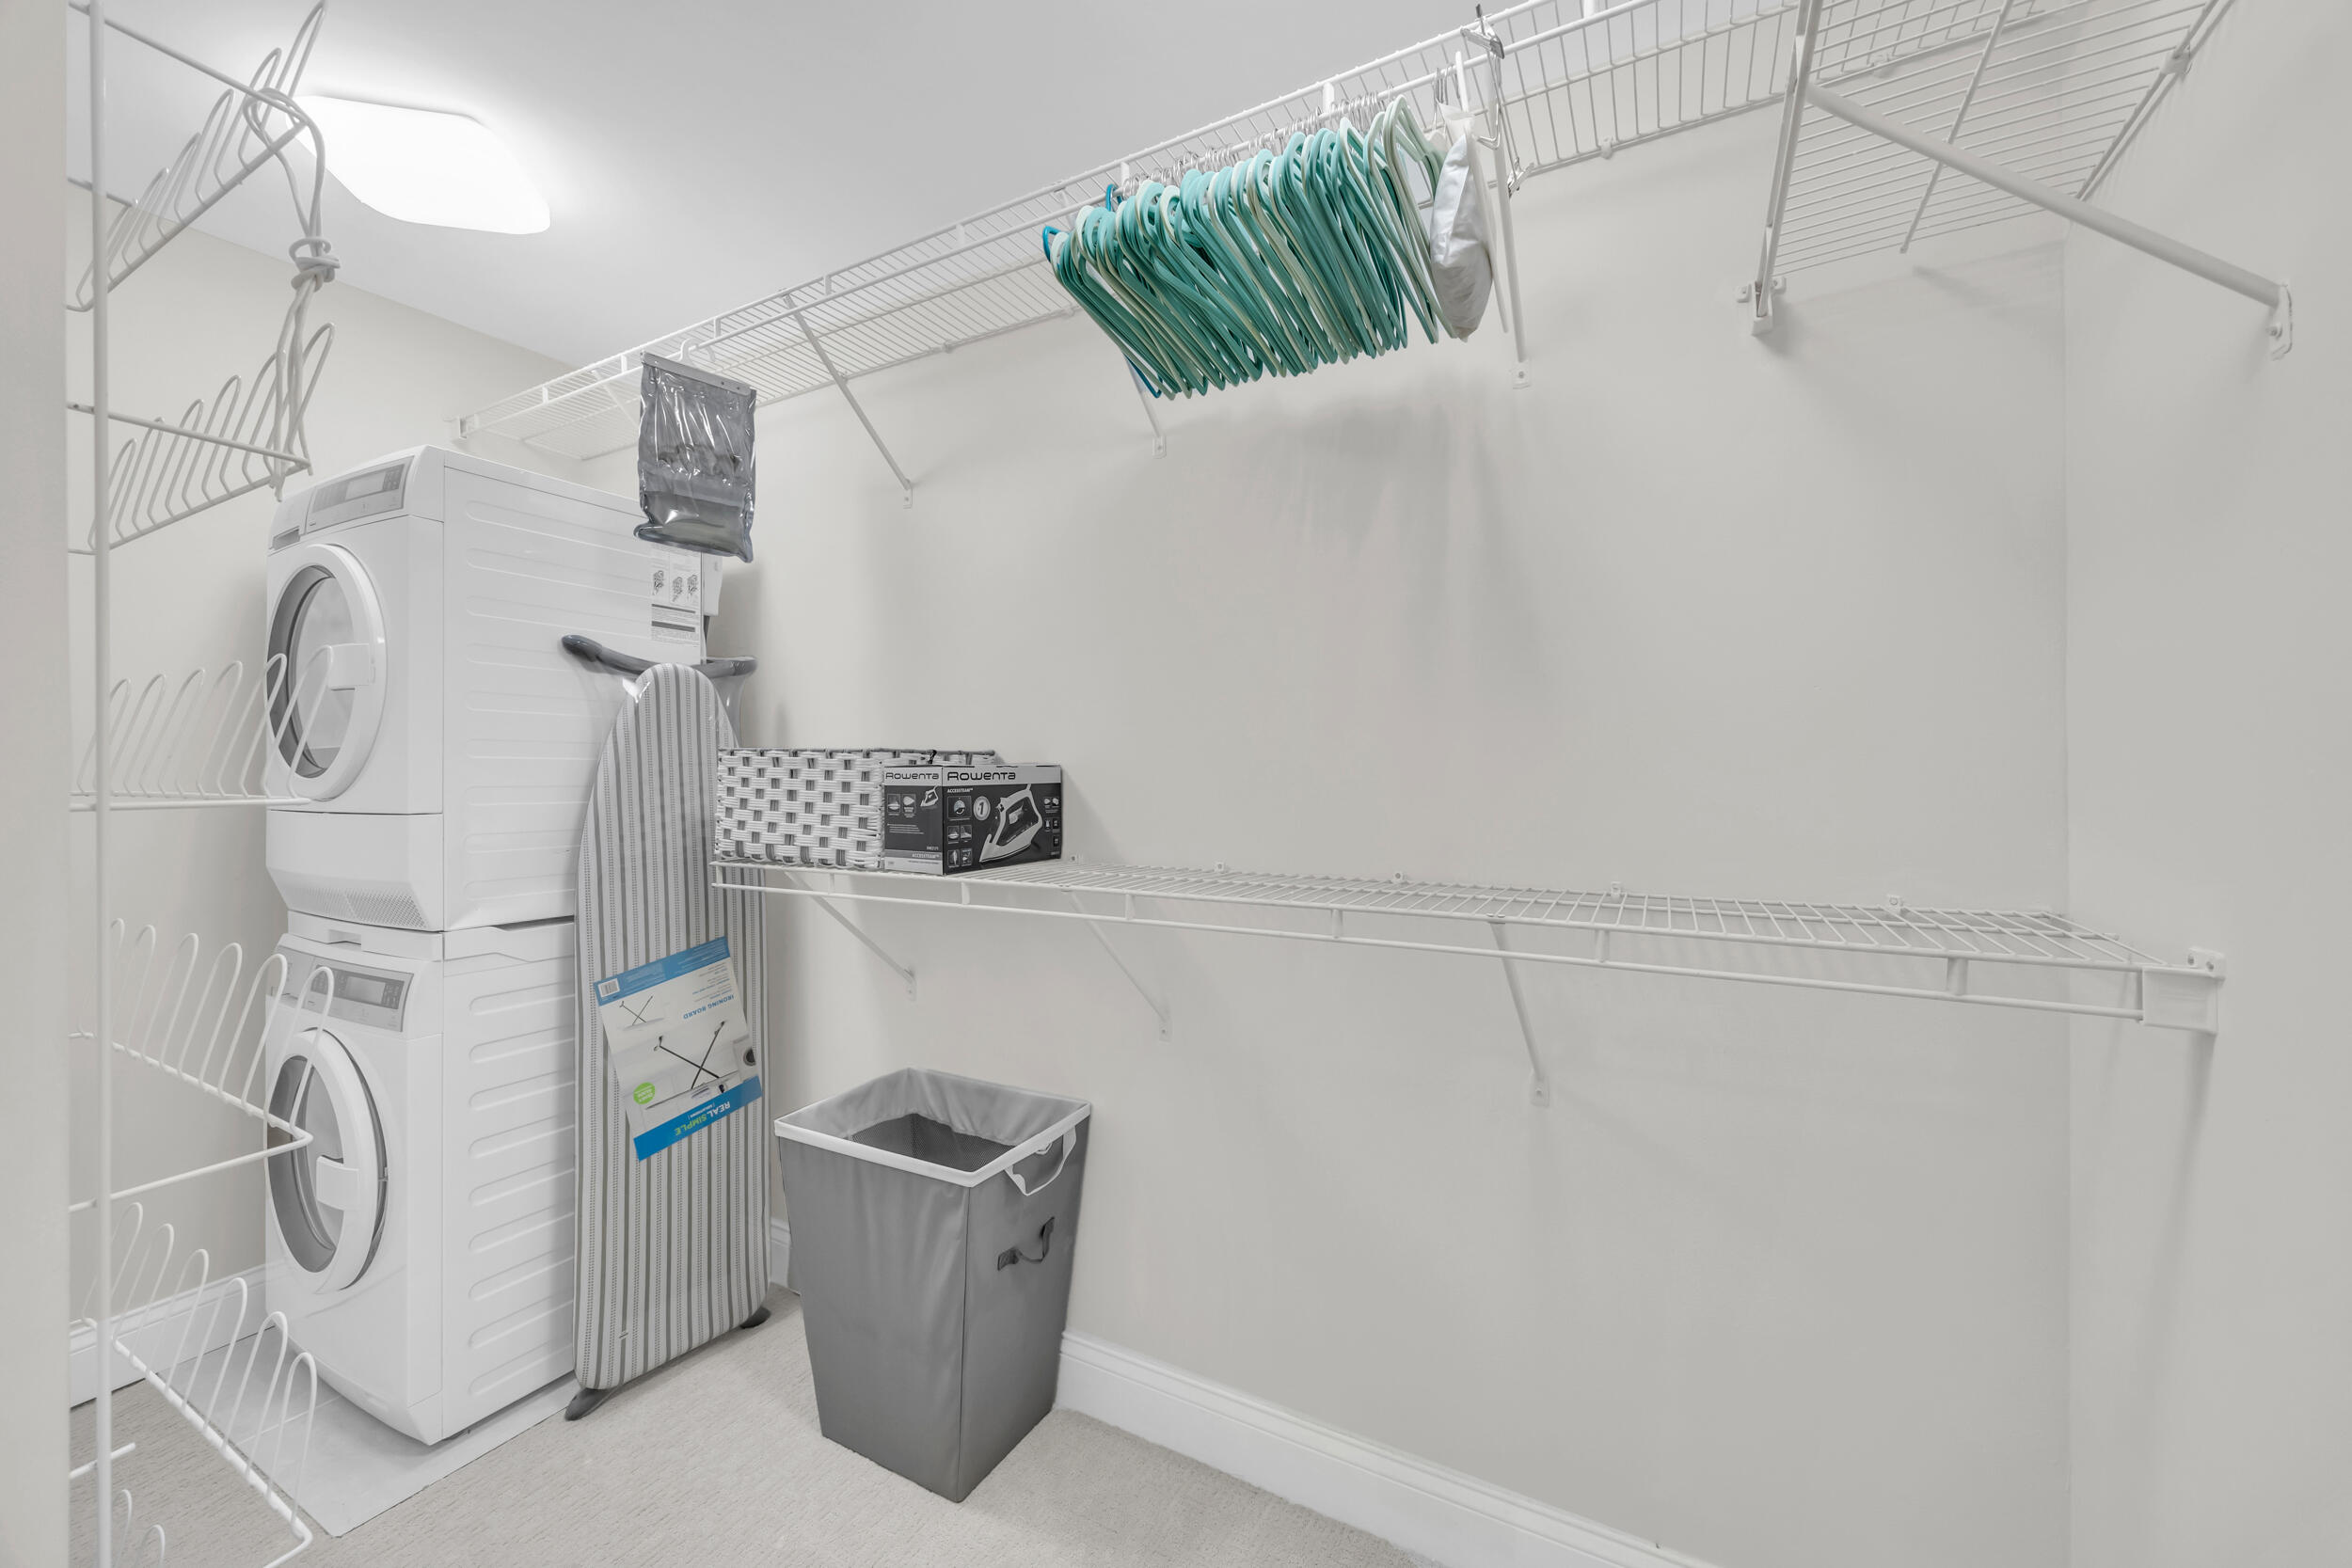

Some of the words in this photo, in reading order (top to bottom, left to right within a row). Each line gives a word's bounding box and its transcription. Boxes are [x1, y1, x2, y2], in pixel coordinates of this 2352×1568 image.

[707, 994, 734, 1008] IRONING
[707, 1101, 730, 1117] REAL
[675, 1114, 707, 1136] SIMPLE
